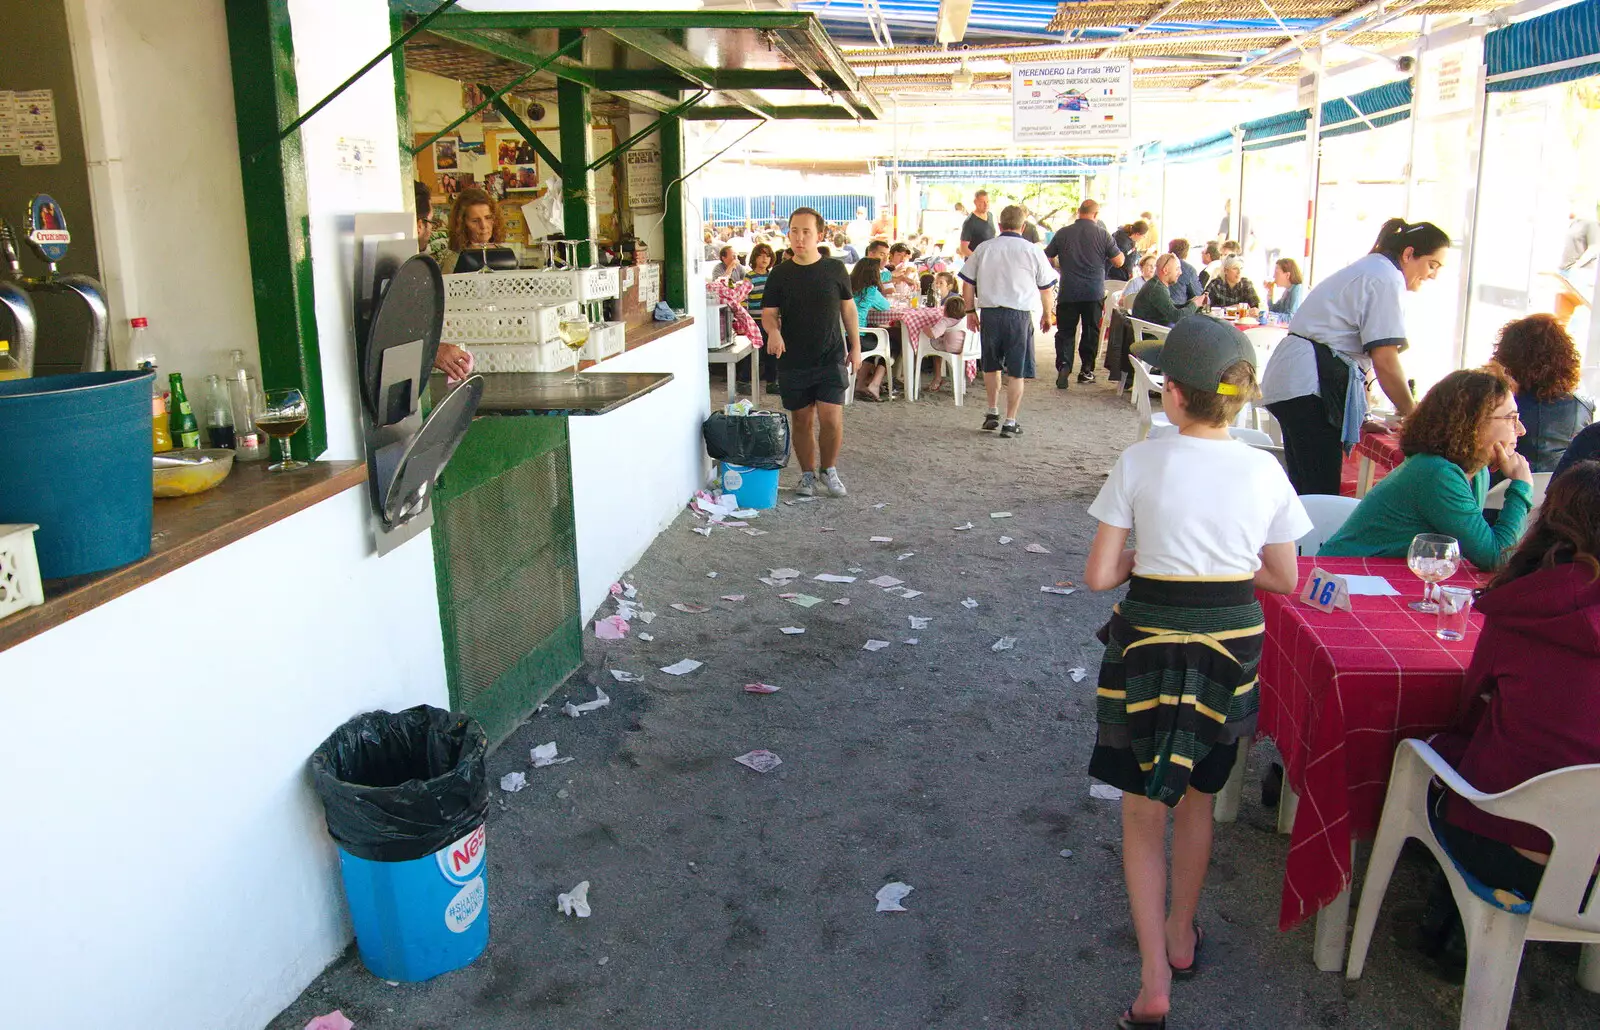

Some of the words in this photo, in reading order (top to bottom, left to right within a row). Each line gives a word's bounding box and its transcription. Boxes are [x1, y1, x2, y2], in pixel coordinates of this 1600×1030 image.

[1018, 68, 1065, 77] MERENDERO
[1076, 67, 1101, 75] Parrala
[1309, 577, 1336, 606] 16
